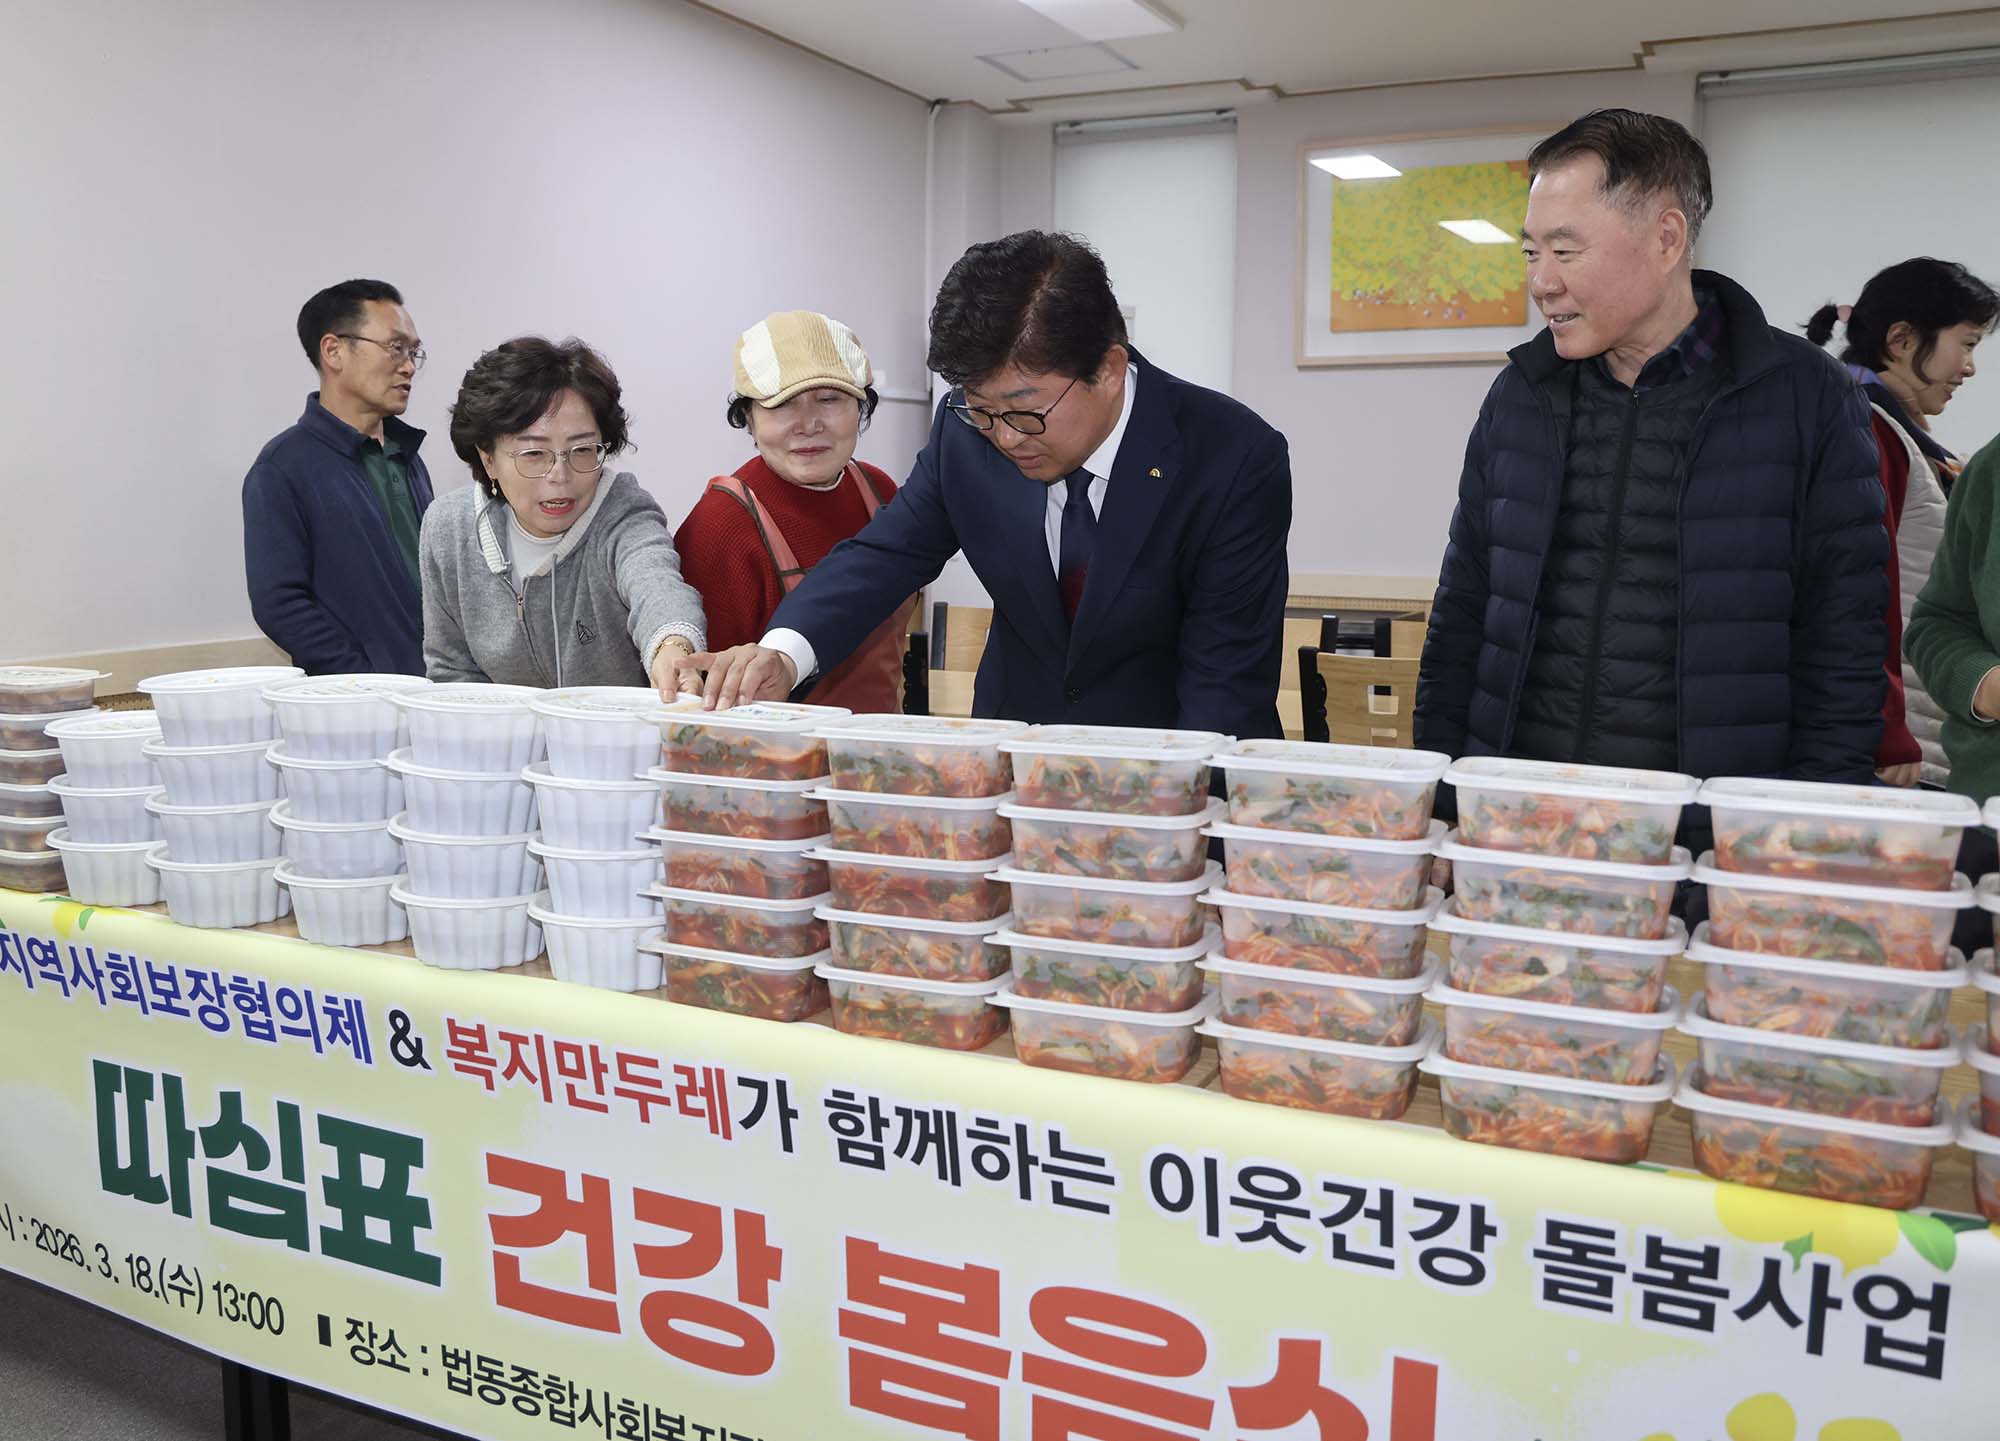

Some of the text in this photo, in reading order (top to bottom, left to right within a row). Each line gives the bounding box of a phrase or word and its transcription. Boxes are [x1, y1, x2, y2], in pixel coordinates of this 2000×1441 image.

[0, 931, 1951, 1380] 지역사회보장협의체 & 복지만두레가 함께하는 이웃건강 돌봄사업
[92, 1059, 442, 1287] 따심표
[485, 1152, 783, 1376] 건강
[212, 1280, 285, 1336] 13:00
[345, 1317, 410, 1373] 장소
